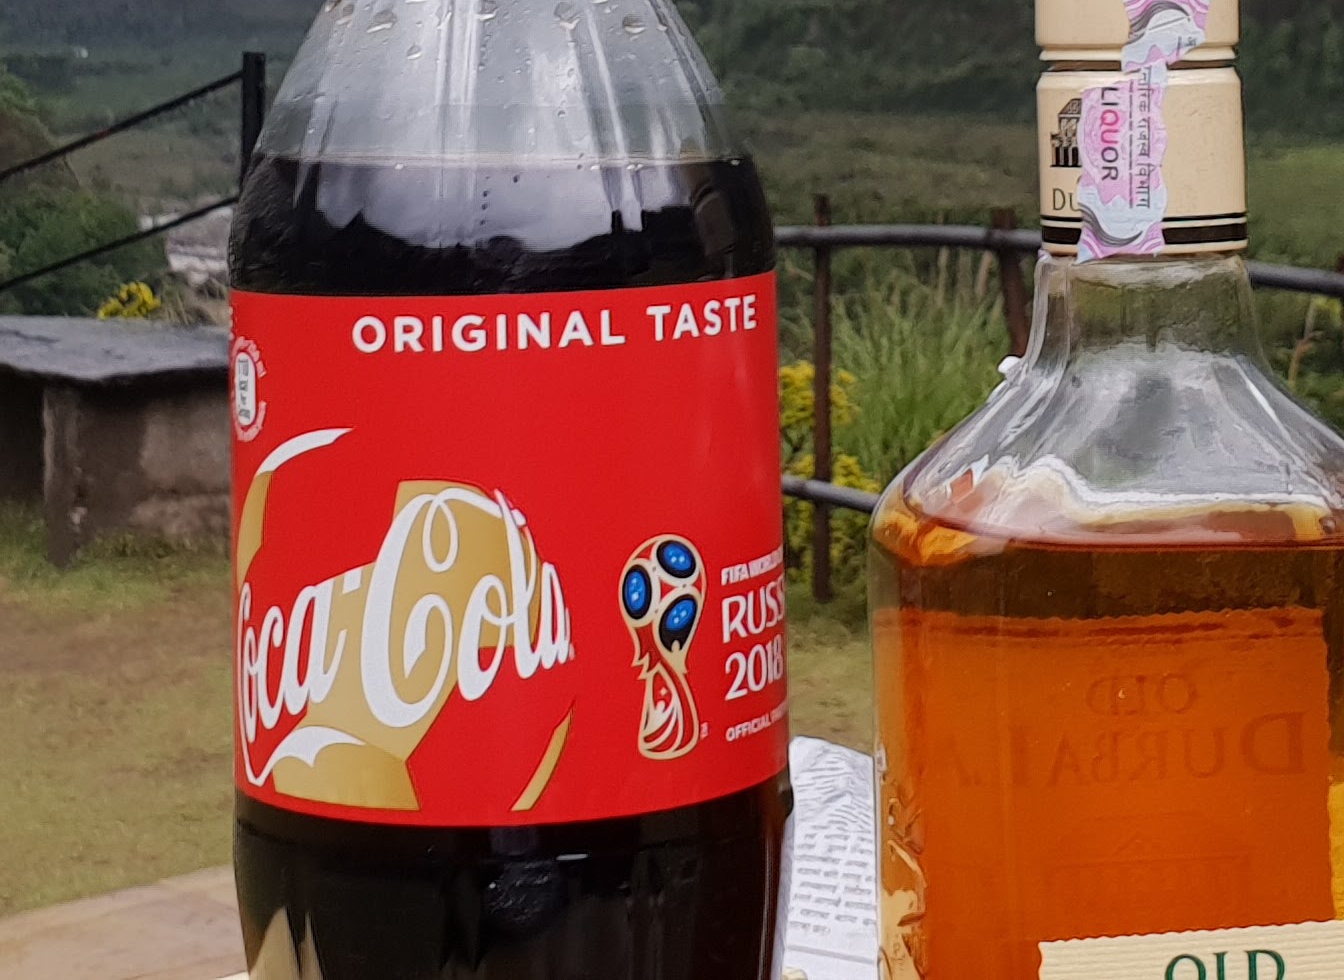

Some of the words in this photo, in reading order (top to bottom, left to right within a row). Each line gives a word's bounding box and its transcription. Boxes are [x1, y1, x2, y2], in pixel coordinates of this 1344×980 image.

[1100, 86, 1120, 181] LIQUOR
[1136, 116, 1151, 159] राजस्व
[1135, 162, 1156, 209] विभाग
[351, 308, 626, 353] ORIGINAL
[645, 294, 757, 343] TASTE
[721, 564, 749, 586] FIFA
[238, 487, 572, 787] Coca-Cola
[724, 633, 784, 701] 2018
[725, 713, 772, 742] OFFICIAL
